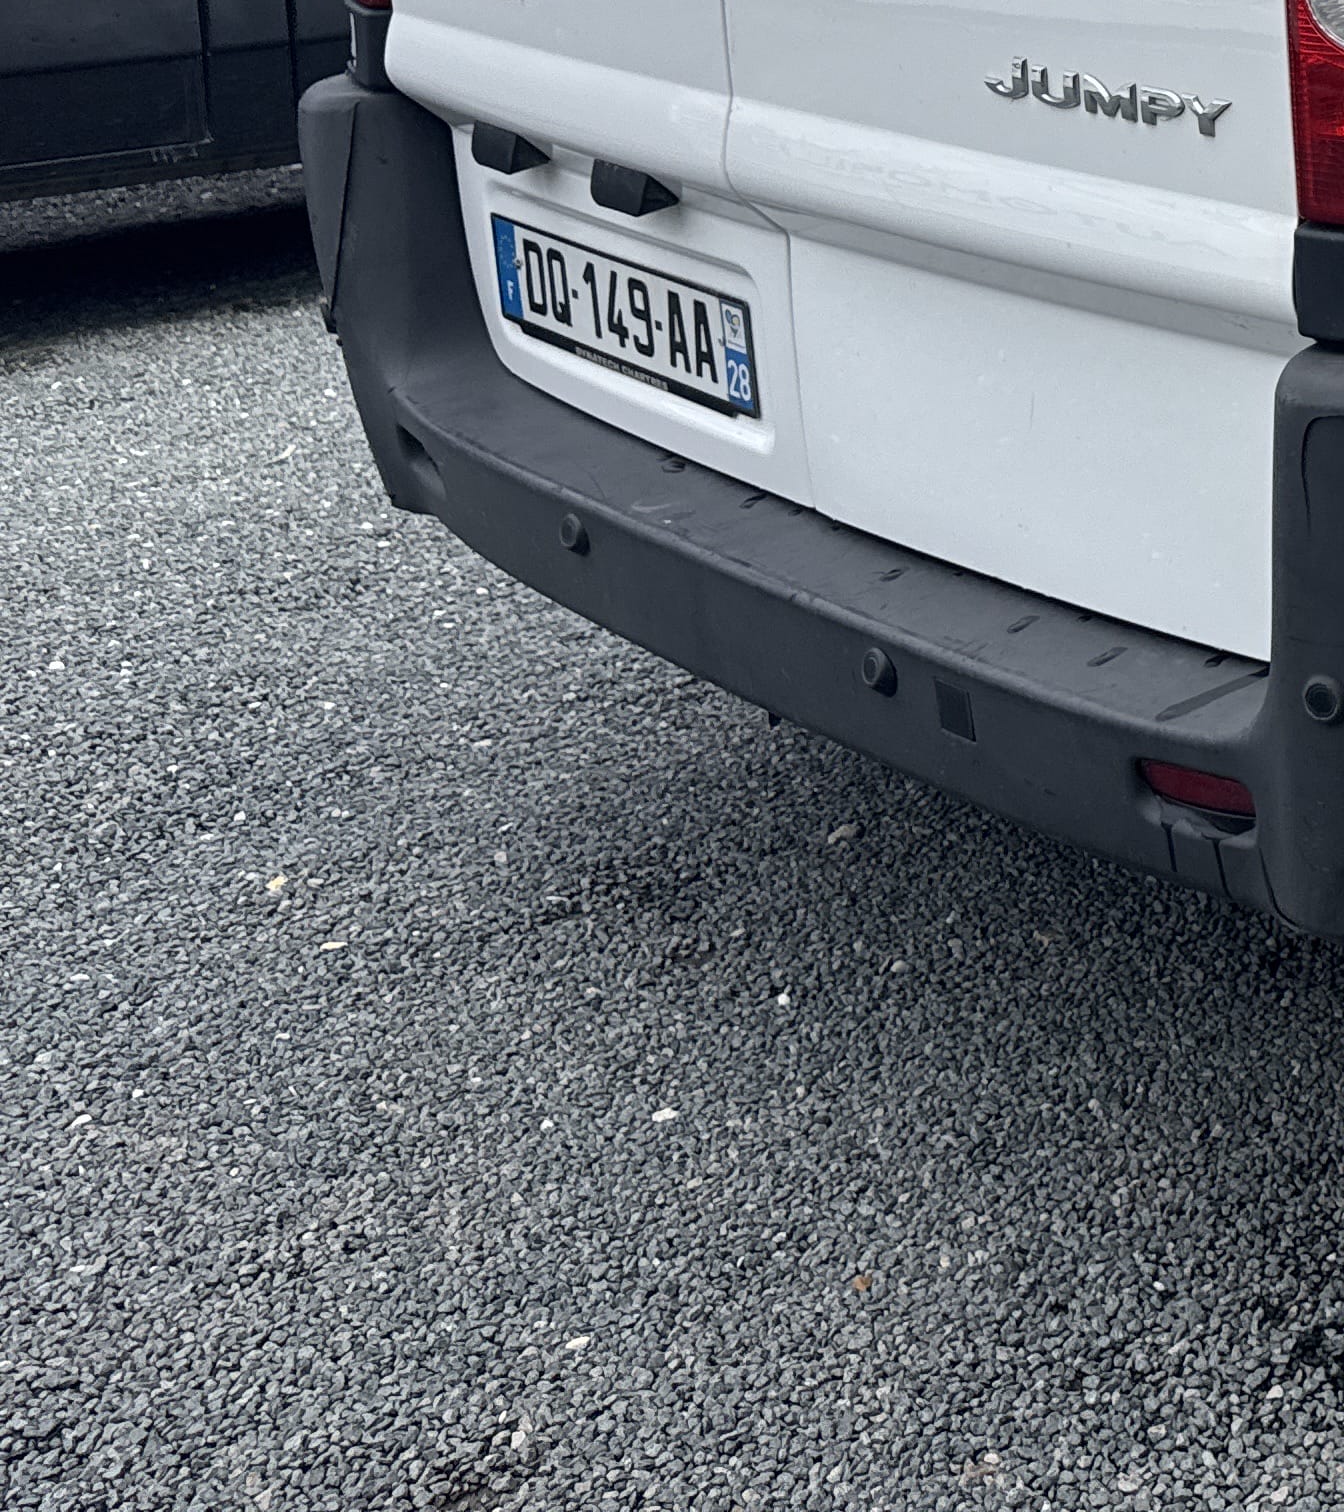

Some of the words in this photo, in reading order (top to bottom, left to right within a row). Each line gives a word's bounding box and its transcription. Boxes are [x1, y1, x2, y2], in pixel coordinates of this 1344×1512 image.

[984, 55, 1232, 138] JUMPY
[522, 238, 719, 384] DQ-149-AA
[727, 359, 752, 402] 28
